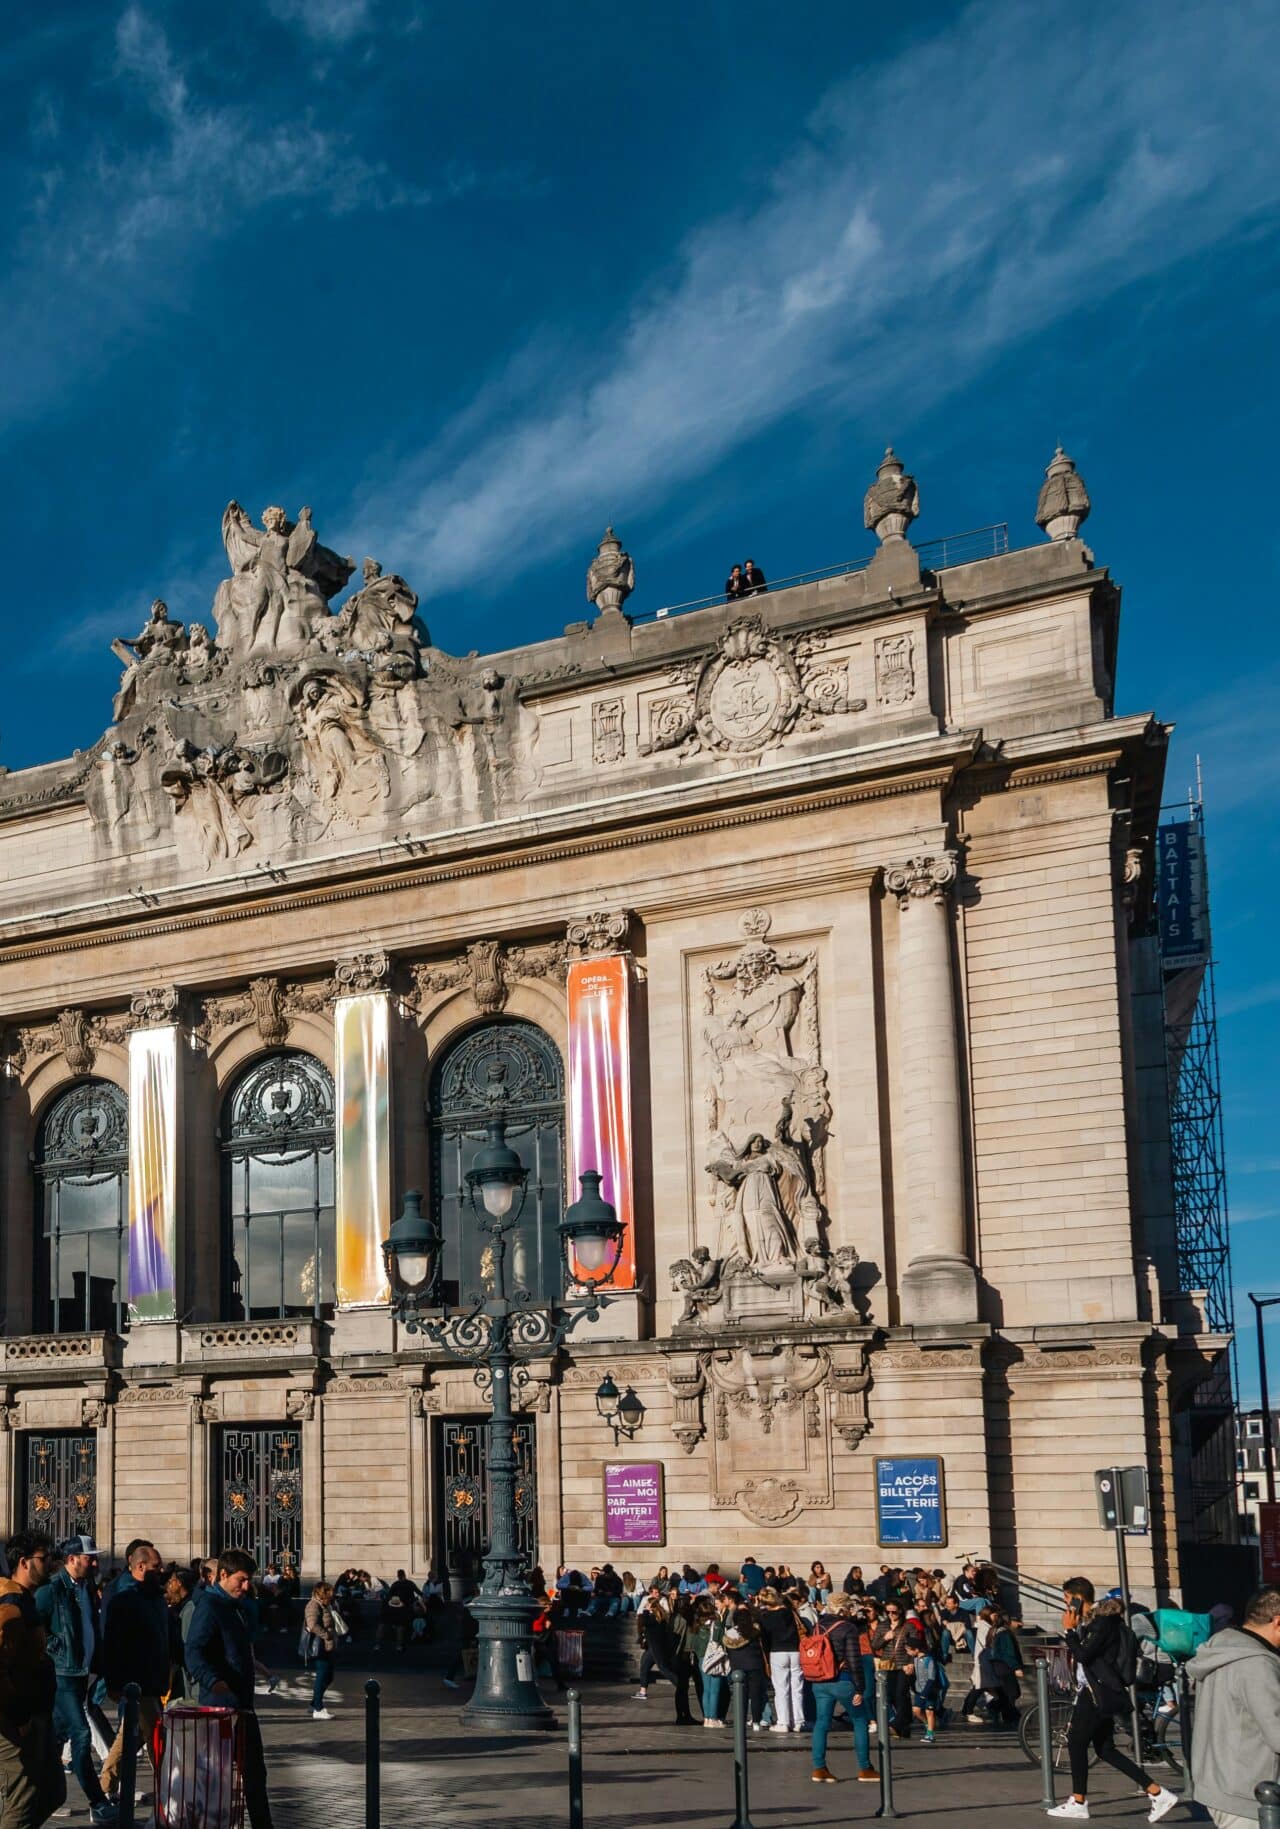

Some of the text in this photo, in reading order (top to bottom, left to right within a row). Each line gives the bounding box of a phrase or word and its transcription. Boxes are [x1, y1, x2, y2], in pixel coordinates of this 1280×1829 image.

[1164, 832, 1181, 937] BATTAIS
[894, 1474, 937, 1486] ACCÈS
[637, 1488, 657, 1497] MOI
[880, 1487, 919, 1497] BILLET
[607, 1498, 626, 1506] PAR
[904, 1498, 939, 1508] TERIE
